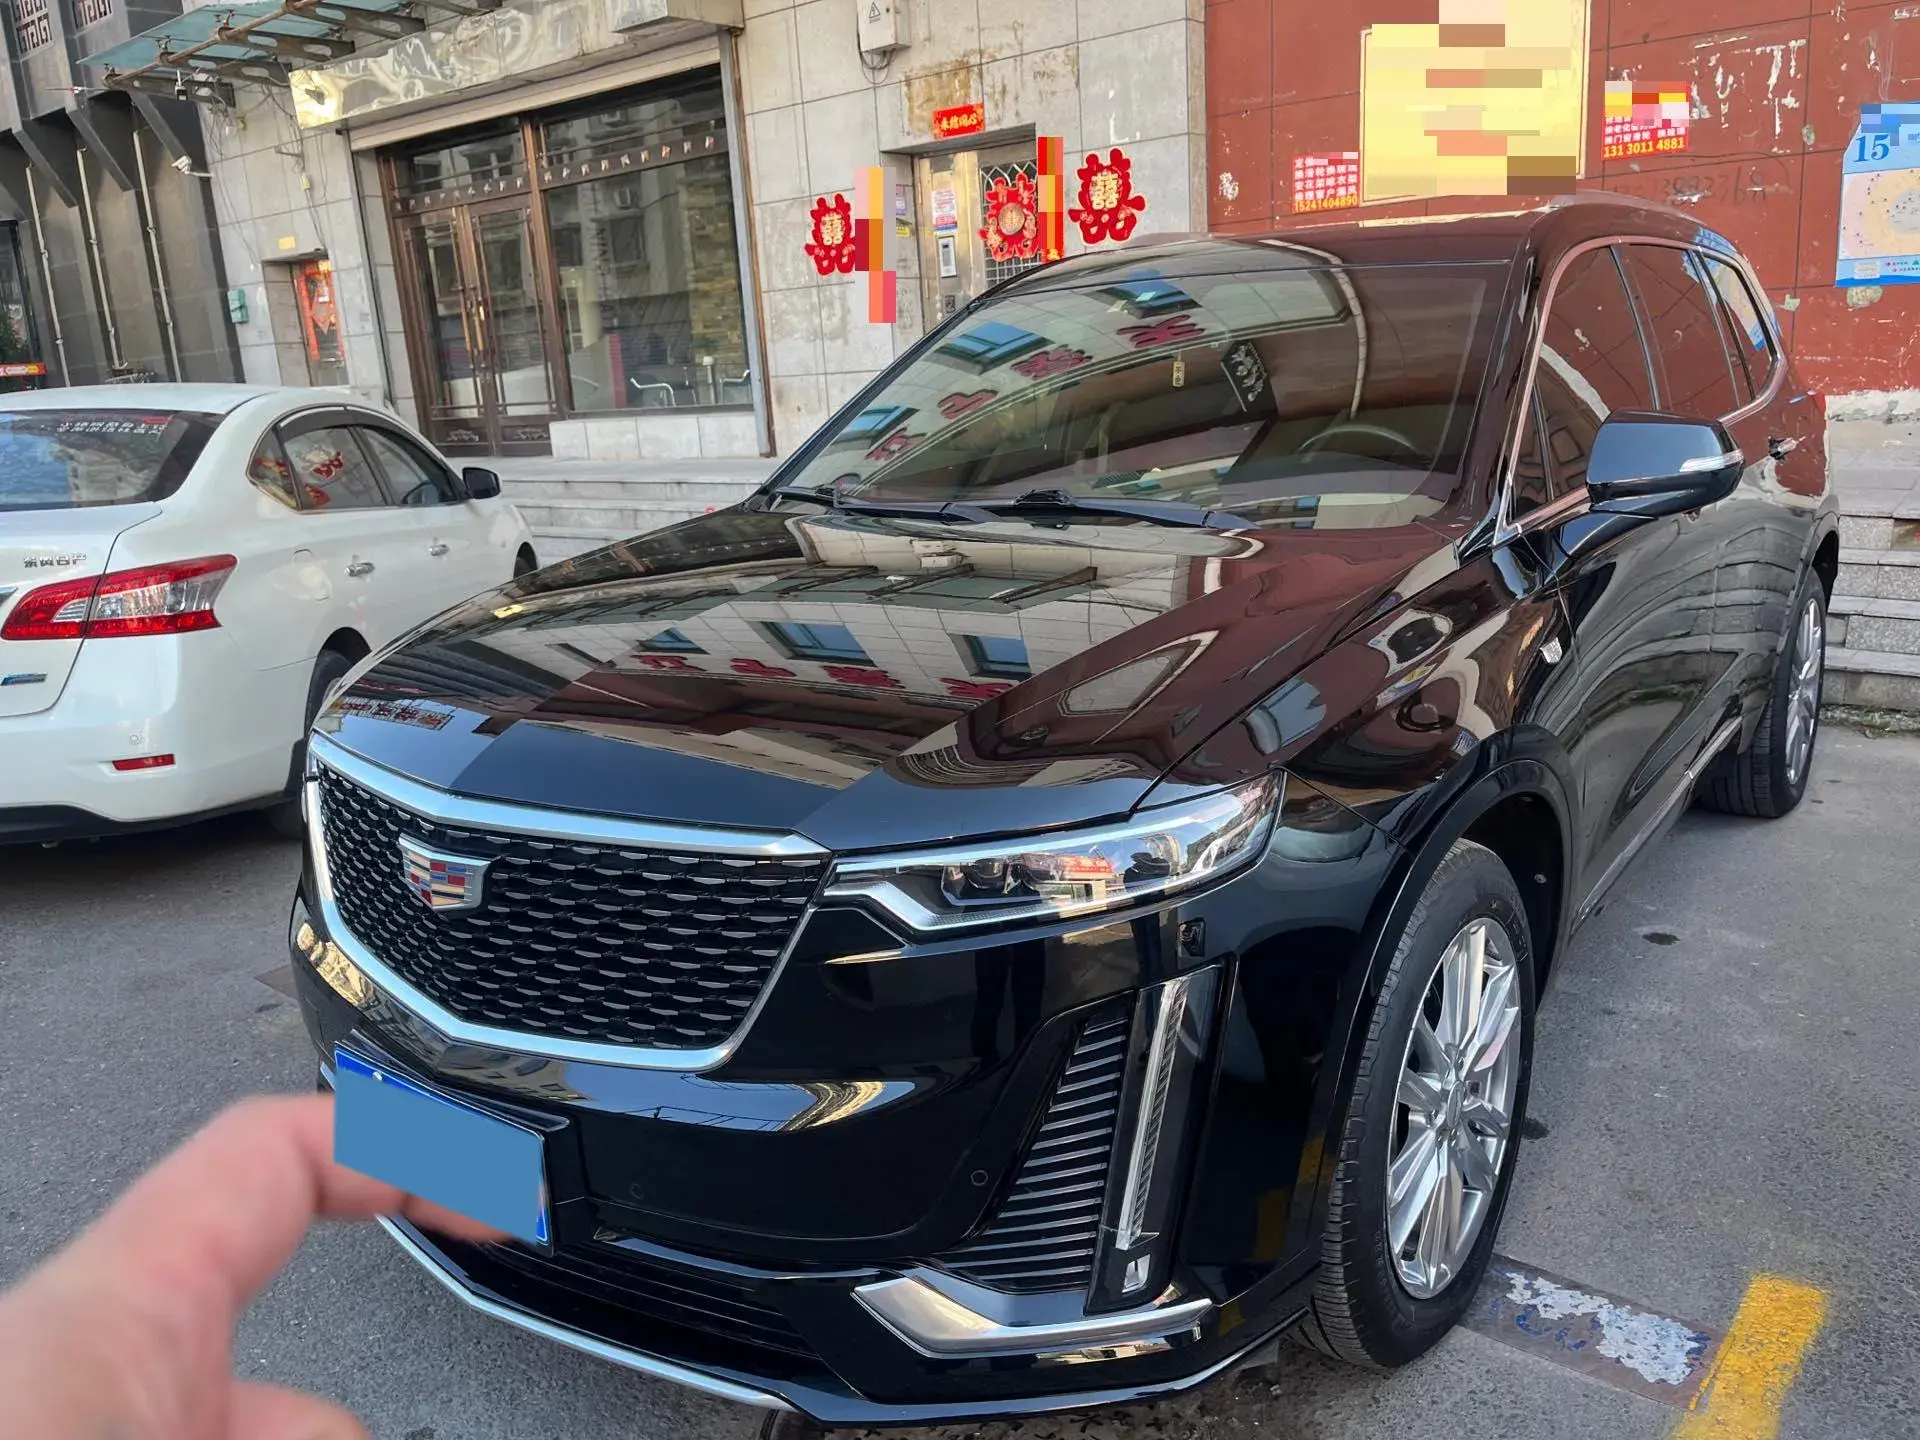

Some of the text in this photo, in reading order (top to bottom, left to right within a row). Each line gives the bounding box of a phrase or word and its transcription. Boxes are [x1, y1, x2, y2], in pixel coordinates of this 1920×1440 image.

[1604, 137, 1685, 158] 131 3011 4881
[1853, 133, 1890, 163] 15
[1295, 194, 1358, 212] 15241404890
[23, 552, 87, 568] 东风日产
